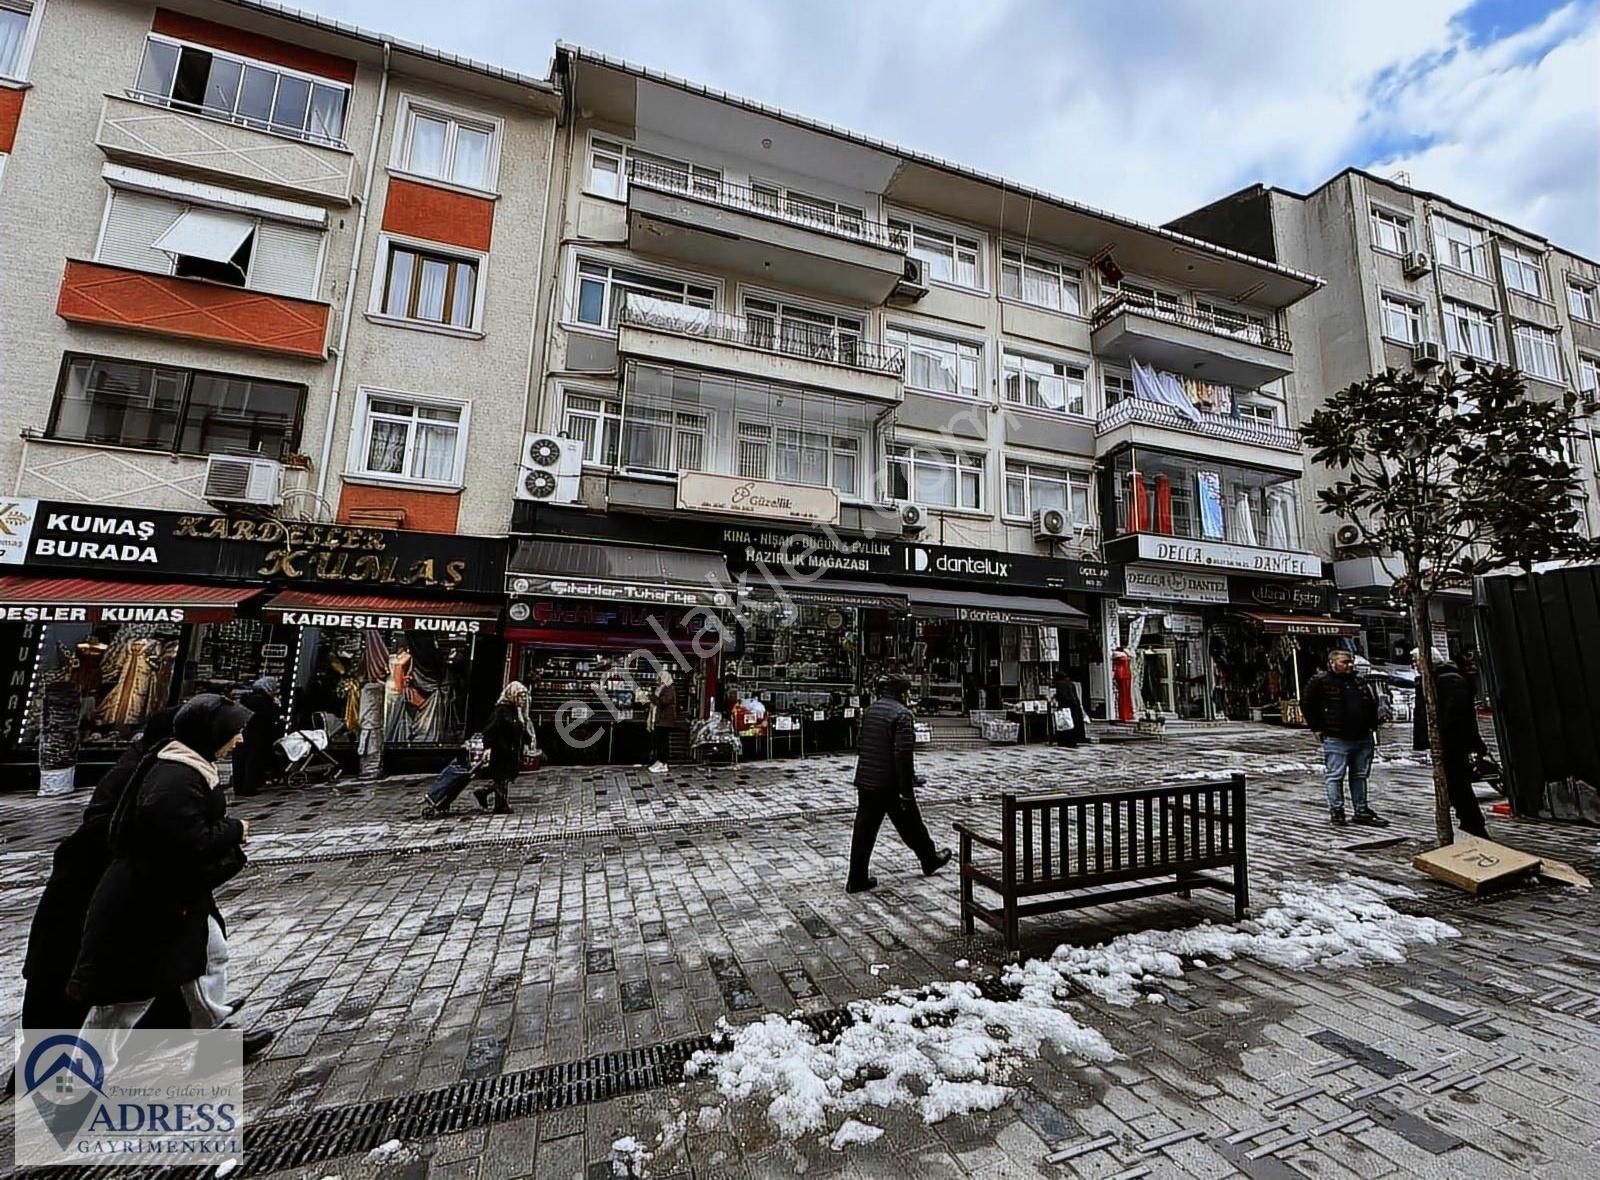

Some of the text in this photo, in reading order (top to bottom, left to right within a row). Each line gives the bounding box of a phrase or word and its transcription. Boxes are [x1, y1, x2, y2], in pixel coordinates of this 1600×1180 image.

[47, 513, 155, 541] KUMAŞ
[172, 516, 387, 550] KARDEŞLER
[723, 530, 751, 543] KINA
[35, 539, 159, 563] BURADA
[745, 550, 869, 571] HAZIRLIK MAĞAZASI
[1157, 543, 1203, 563] DELLA
[1254, 553, 1307, 574] DANTEL
[257, 550, 466, 590] KUMAŞ
[936, 554, 1009, 577] dantelux
[1128, 572, 1166, 587] DELLA
[101, 608, 185, 623] KUMAŞ
[282, 612, 480, 633] KARDEŞLER KUMAŞ
